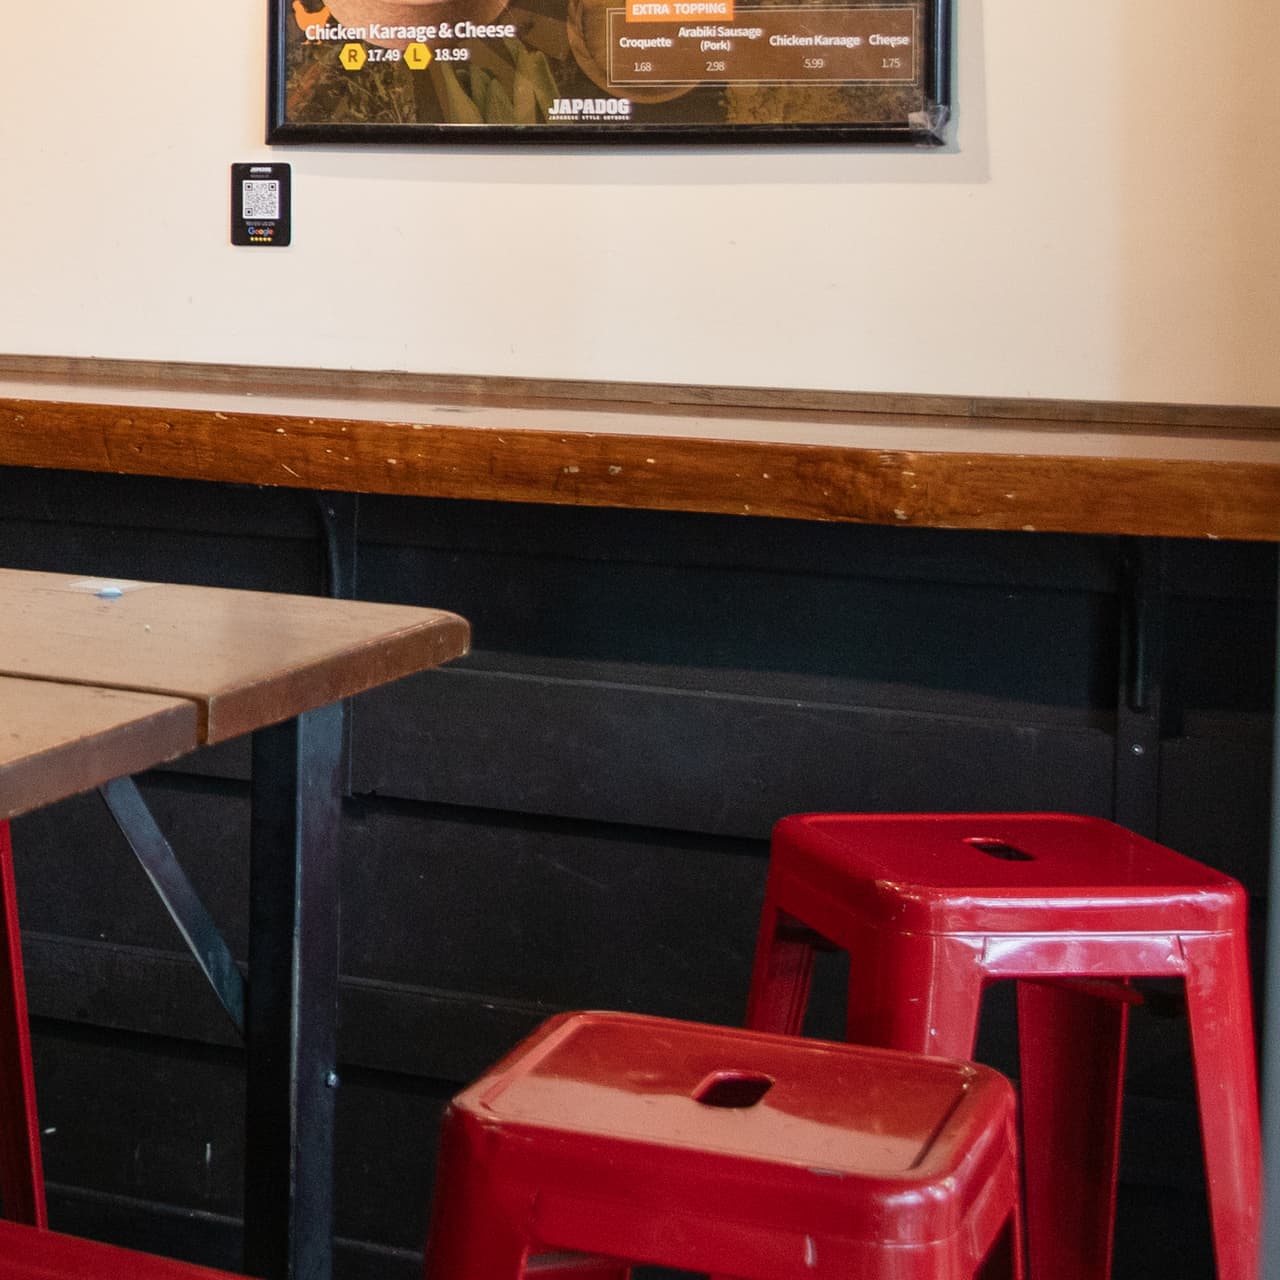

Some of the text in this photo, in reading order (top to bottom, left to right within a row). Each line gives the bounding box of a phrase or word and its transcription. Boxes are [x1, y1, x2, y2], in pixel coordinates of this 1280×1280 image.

[632, 2, 727, 16] EXTRA TOPPING
[305, 21, 515, 43] Chicken Karaage & Cheese
[678, 26, 762, 40] Arabiki Sausage
[619, 36, 672, 50] Croquette
[700, 40, 731, 52] (Pork)
[769, 34, 861, 48] Chicken Karaage
[868, 34, 910, 46] Cheese
[348, 48, 469, 63] R 17.49 L 18.99
[633, 62, 652, 72] 1.68
[706, 61, 725, 72] 2.98
[803, 58, 824, 69] 5.99
[882, 57, 901, 69] 1.75
[548, 98, 630, 115] JAPADOG
